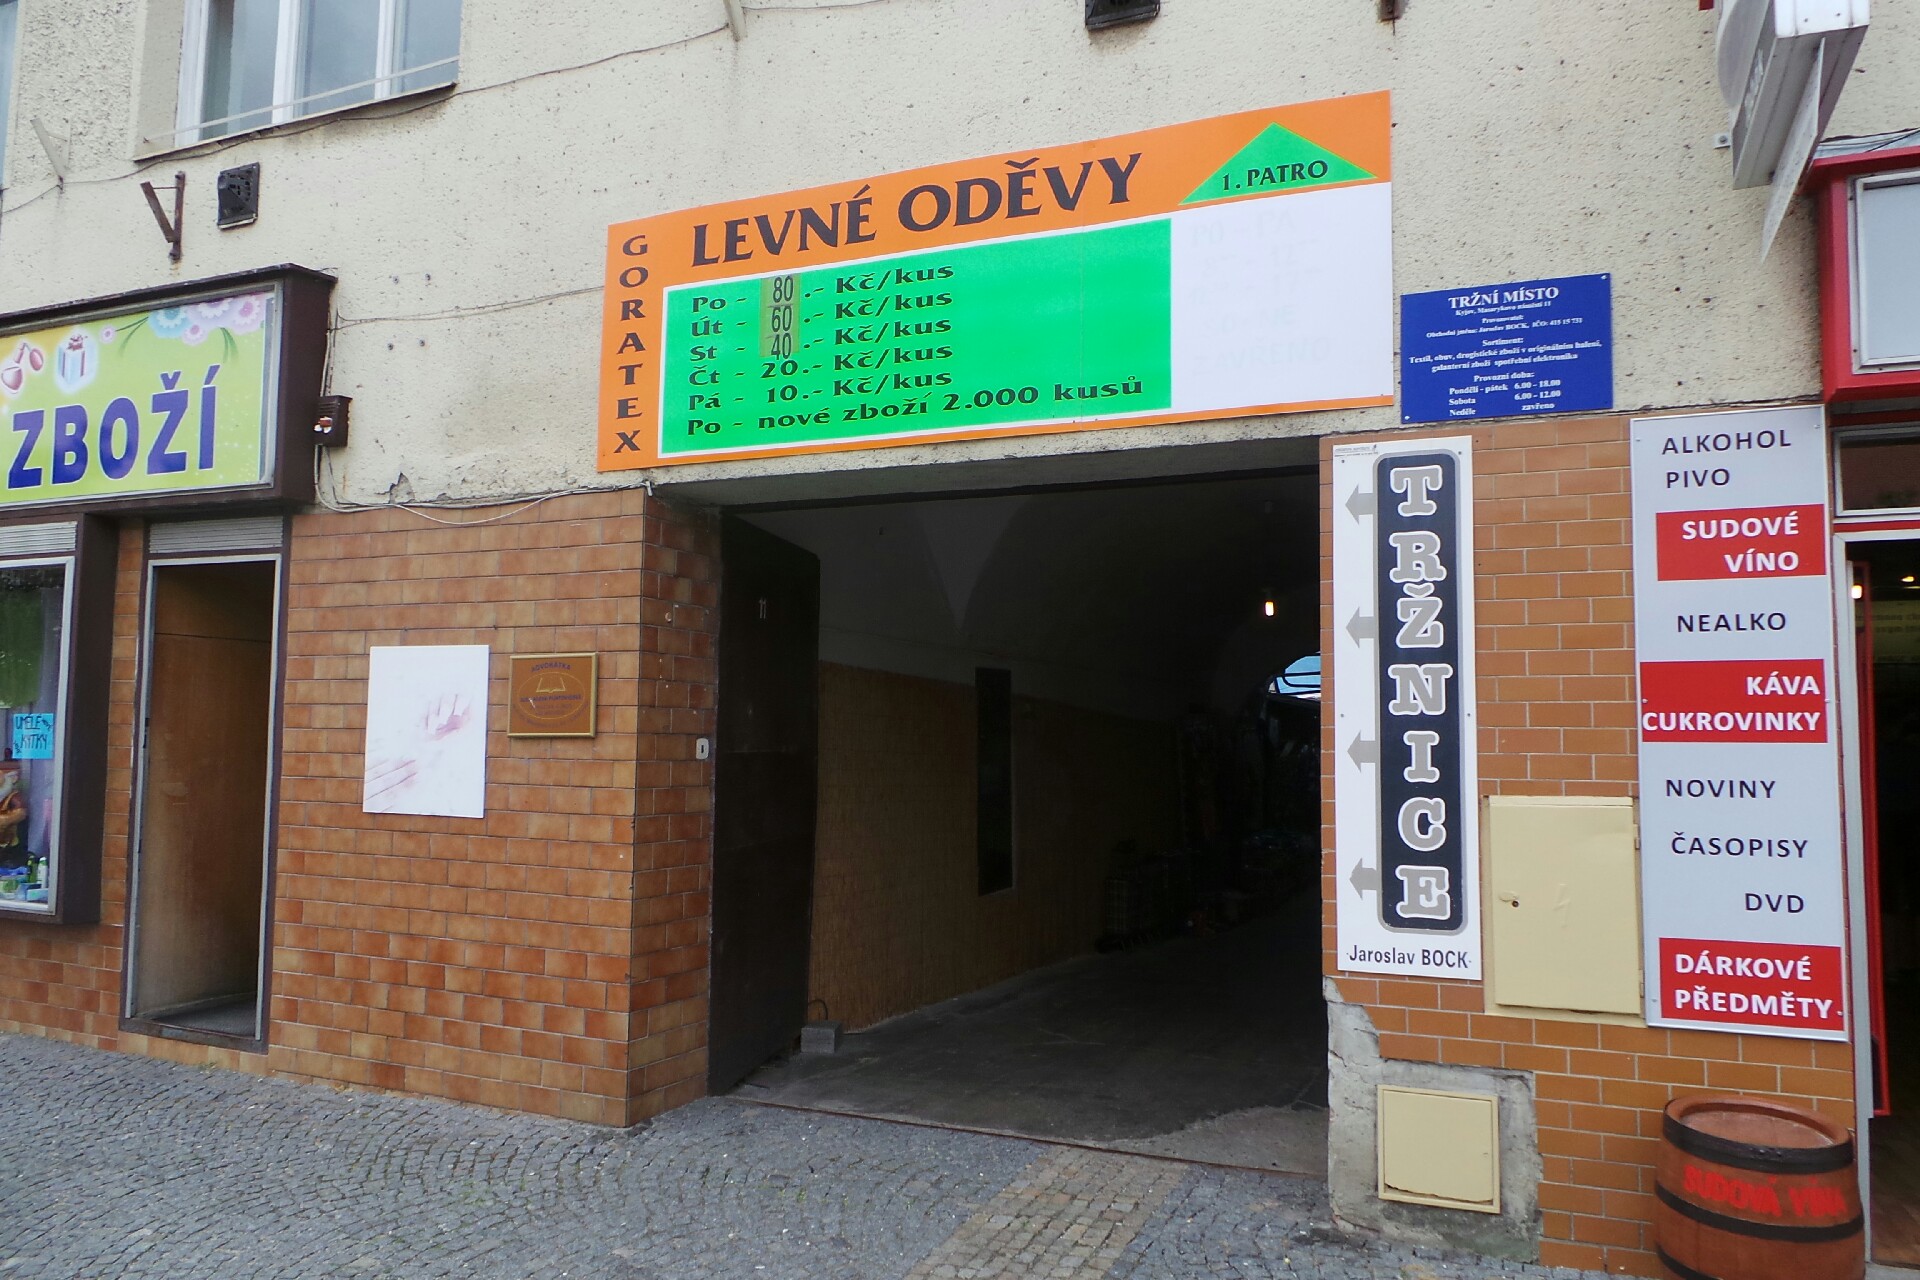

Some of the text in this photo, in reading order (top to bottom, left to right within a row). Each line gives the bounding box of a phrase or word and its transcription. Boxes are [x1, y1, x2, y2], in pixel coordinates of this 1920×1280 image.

[1223, 160, 1328, 191] 1. PATRO
[691, 152, 1142, 267] LEVNÉ ODĚVY
[692, 297, 726, 313] Po
[836, 265, 954, 294] Kč/kus
[1448, 287, 1559, 308] TRŽNÍ MÍSTO
[691, 316, 723, 337] Út
[835, 292, 953, 320] Kč/kus
[613, 234, 649, 453] GORATEX
[690, 345, 717, 362] St
[835, 319, 952, 345] Kč/kus
[688, 366, 720, 385] Čt
[834, 345, 952, 371] Kč/kus
[1409, 355, 1433, 364] Textil,
[1456, 348, 1498, 359] drogistické
[1471, 359, 1491, 368] zboží
[1449, 385, 1479, 395] Pondělí
[1485, 384, 1509, 393] pátek
[1539, 379, 1561, 388] 18.00
[1473, 371, 1535, 382] Provozní doba:
[688, 392, 721, 411] Pá
[833, 372, 952, 396] Kč/kus
[1448, 397, 1476, 405] Sobota
[1514, 392, 1532, 400] 6.00
[1539, 390, 1561, 398] 12.00
[687, 419, 721, 435] Po
[758, 407, 830, 429] nové
[842, 392, 933, 421] zboží
[942, 385, 1039, 413] 2.000
[1054, 375, 1143, 402] kusů
[1449, 403, 1555, 416] Neděle zavřeno
[7, 364, 221, 489] ZBOŽÍ
[1662, 429, 1791, 454] ALKOHOL
[1666, 468, 1730, 489] PIVO
[1682, 511, 1799, 539] SUDOVÉ
[1724, 548, 1799, 573] VÍNO
[1677, 612, 1787, 632] NEALKO
[1387, 464, 1453, 921] TRŽNICE
[1747, 672, 1820, 695] KÁVA
[1642, 711, 1821, 731] CUKROVINKY
[1666, 779, 1776, 799] NOVINY
[1671, 832, 1808, 858] ČASOPISY
[1745, 893, 1805, 913] DVD
[1349, 945, 1468, 968] Jaroslav BOCK
[1675, 950, 1812, 981] DÁRKOVÉ
[1675, 985, 1832, 1019] PŘEDMĚTY
